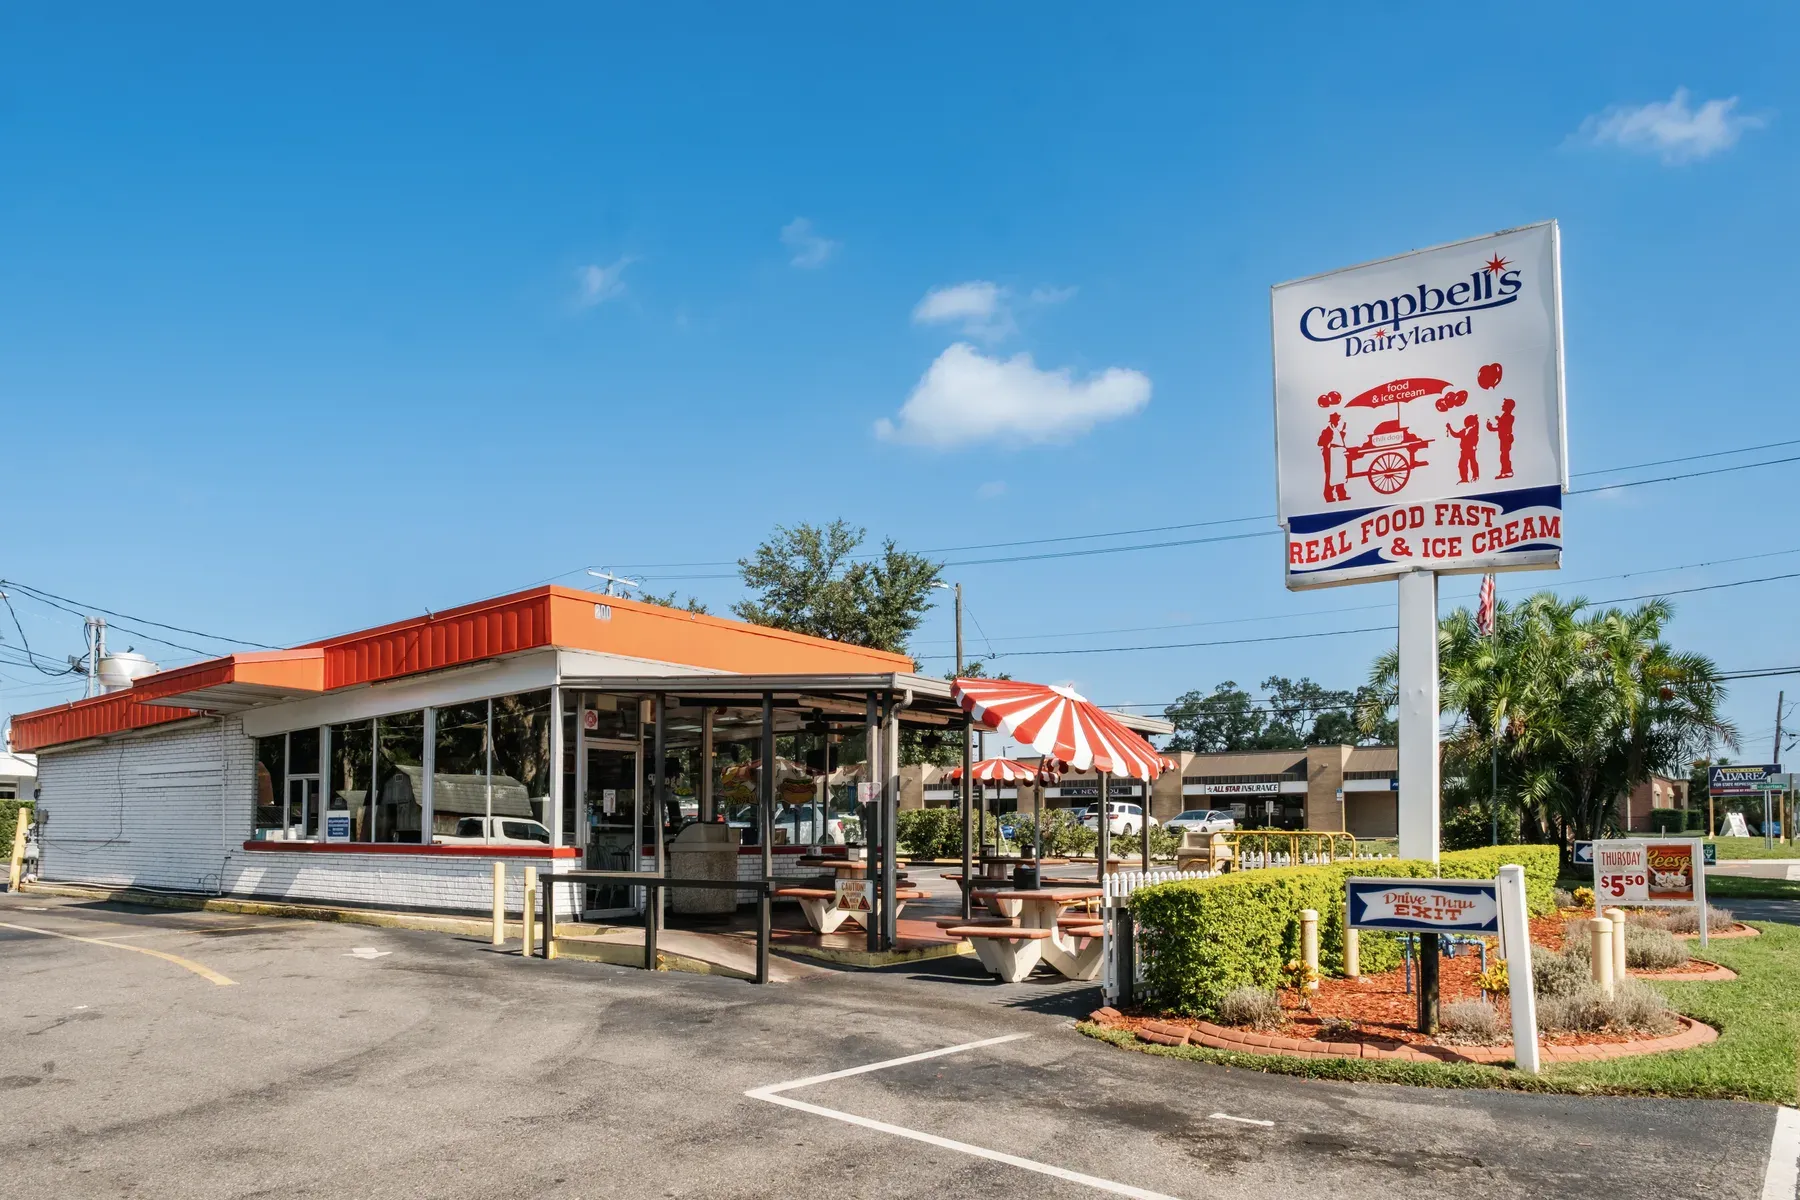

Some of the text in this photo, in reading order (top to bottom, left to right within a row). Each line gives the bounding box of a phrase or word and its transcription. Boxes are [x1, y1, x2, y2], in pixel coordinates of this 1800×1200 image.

[1345, 316, 1472, 358] Dairyland
[1387, 381, 1409, 392] food
[1371, 388, 1426, 404] & ice cream
[1290, 504, 1496, 564] REAL FOOD FAST
[1391, 516, 1561, 558] & ICE CREAM
[1712, 768, 1767, 782] ALVAREZ
[1212, 785, 1225, 793] ALL
[1241, 784, 1278, 792] INSURANCE
[1601, 851, 1641, 866] THURSDAY
[1383, 892, 1476, 909] Drive Thru
[1394, 904, 1462, 921] EXIT
